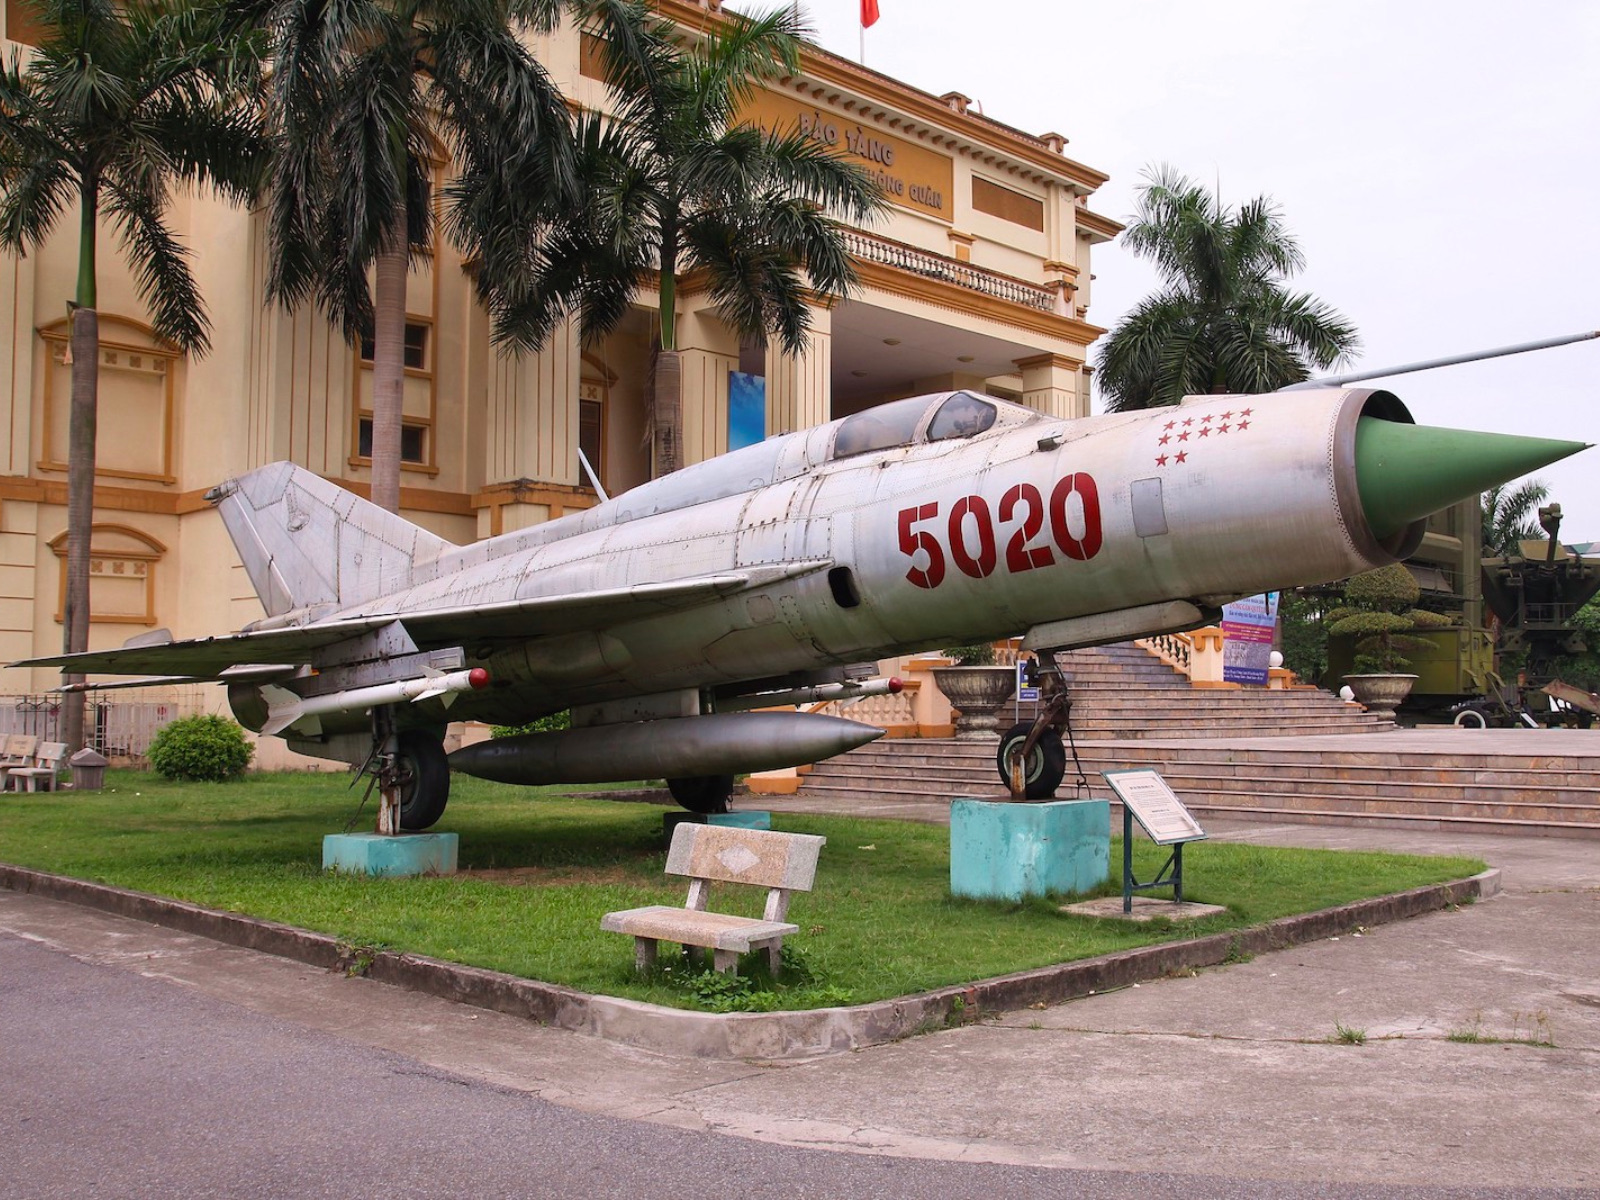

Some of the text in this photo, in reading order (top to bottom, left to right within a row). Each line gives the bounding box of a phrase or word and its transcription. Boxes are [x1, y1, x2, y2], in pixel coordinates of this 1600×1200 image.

[799, 111, 838, 146] BẢO
[845, 126, 894, 166] TÀNG
[908, 183, 943, 210] QUÂN
[898, 472, 1103, 589] 5020
